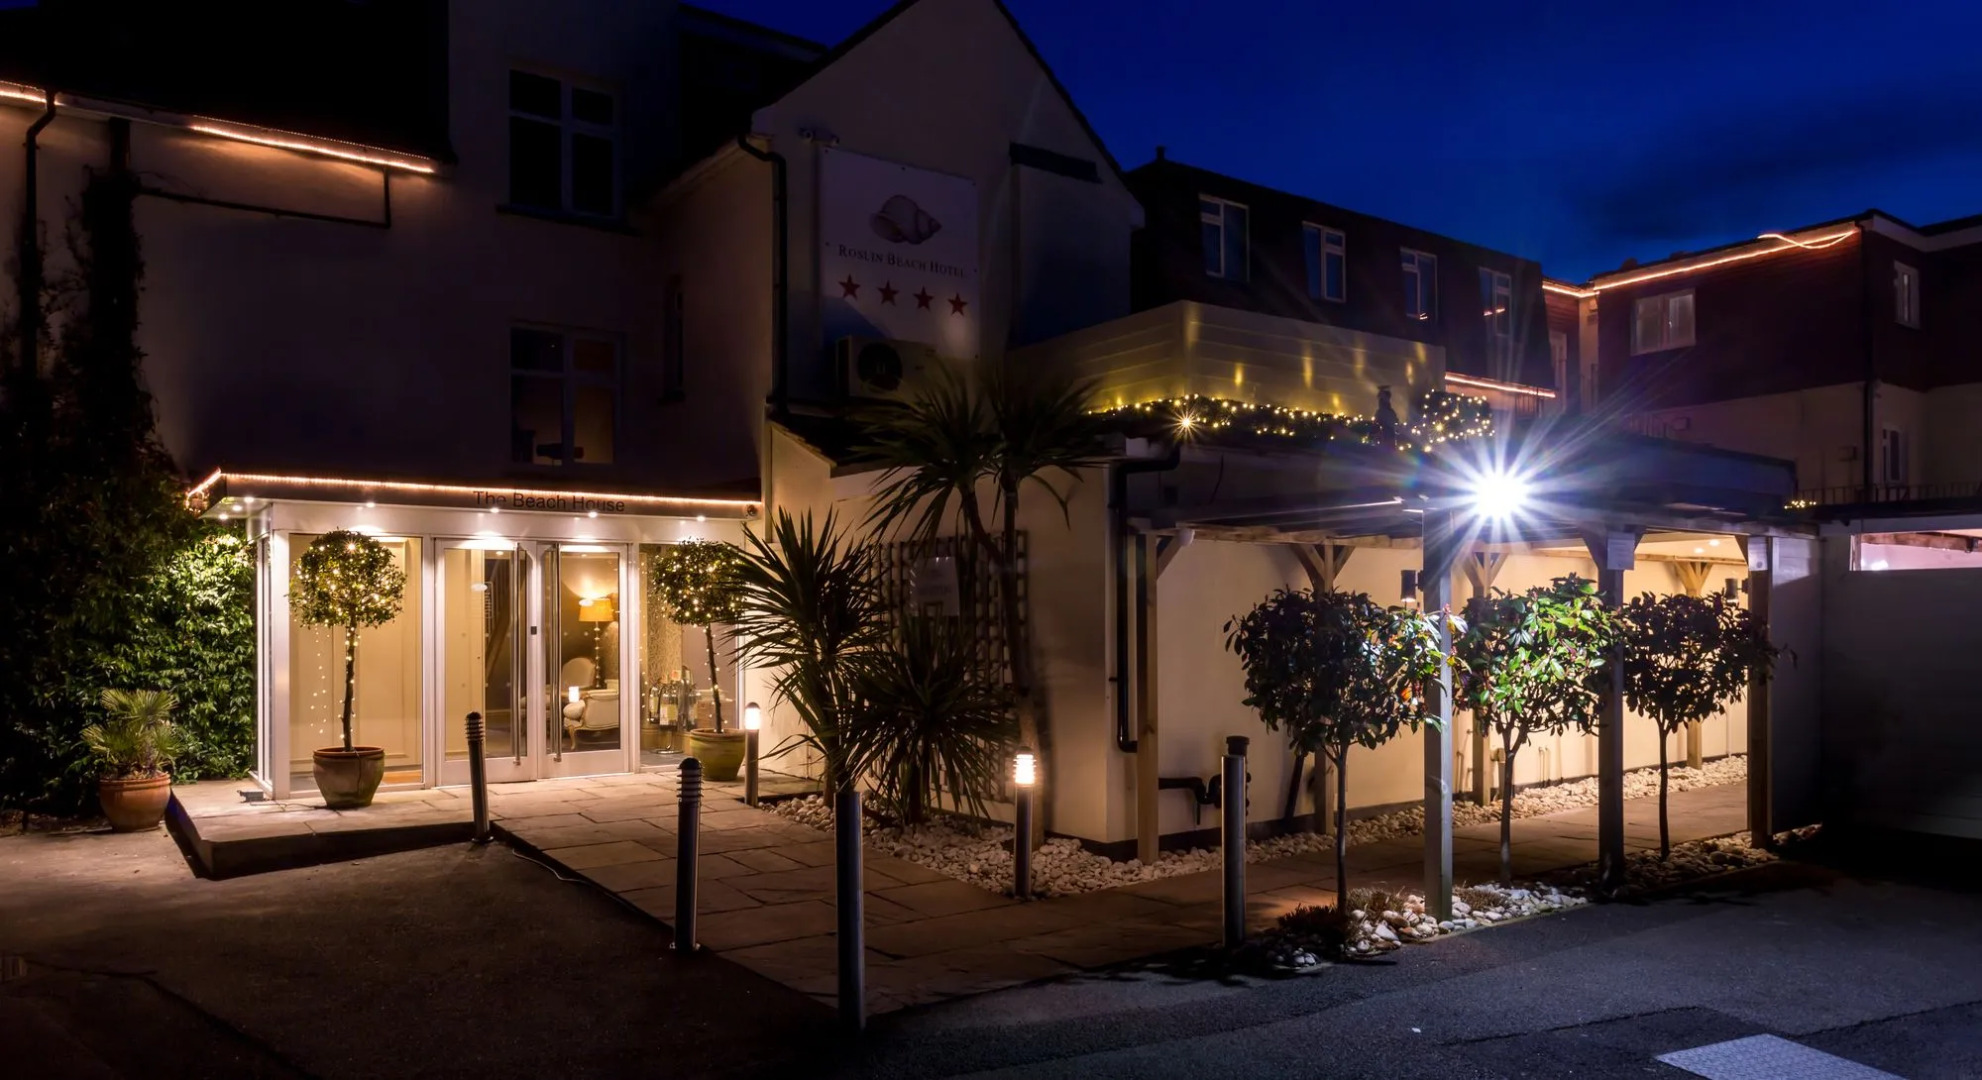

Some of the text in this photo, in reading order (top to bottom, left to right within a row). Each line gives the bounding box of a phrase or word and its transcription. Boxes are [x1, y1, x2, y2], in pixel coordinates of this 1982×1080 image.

[838, 244, 966, 279] ROSLIN BEACH HOTEL
[473, 490, 625, 512] The Beach House
